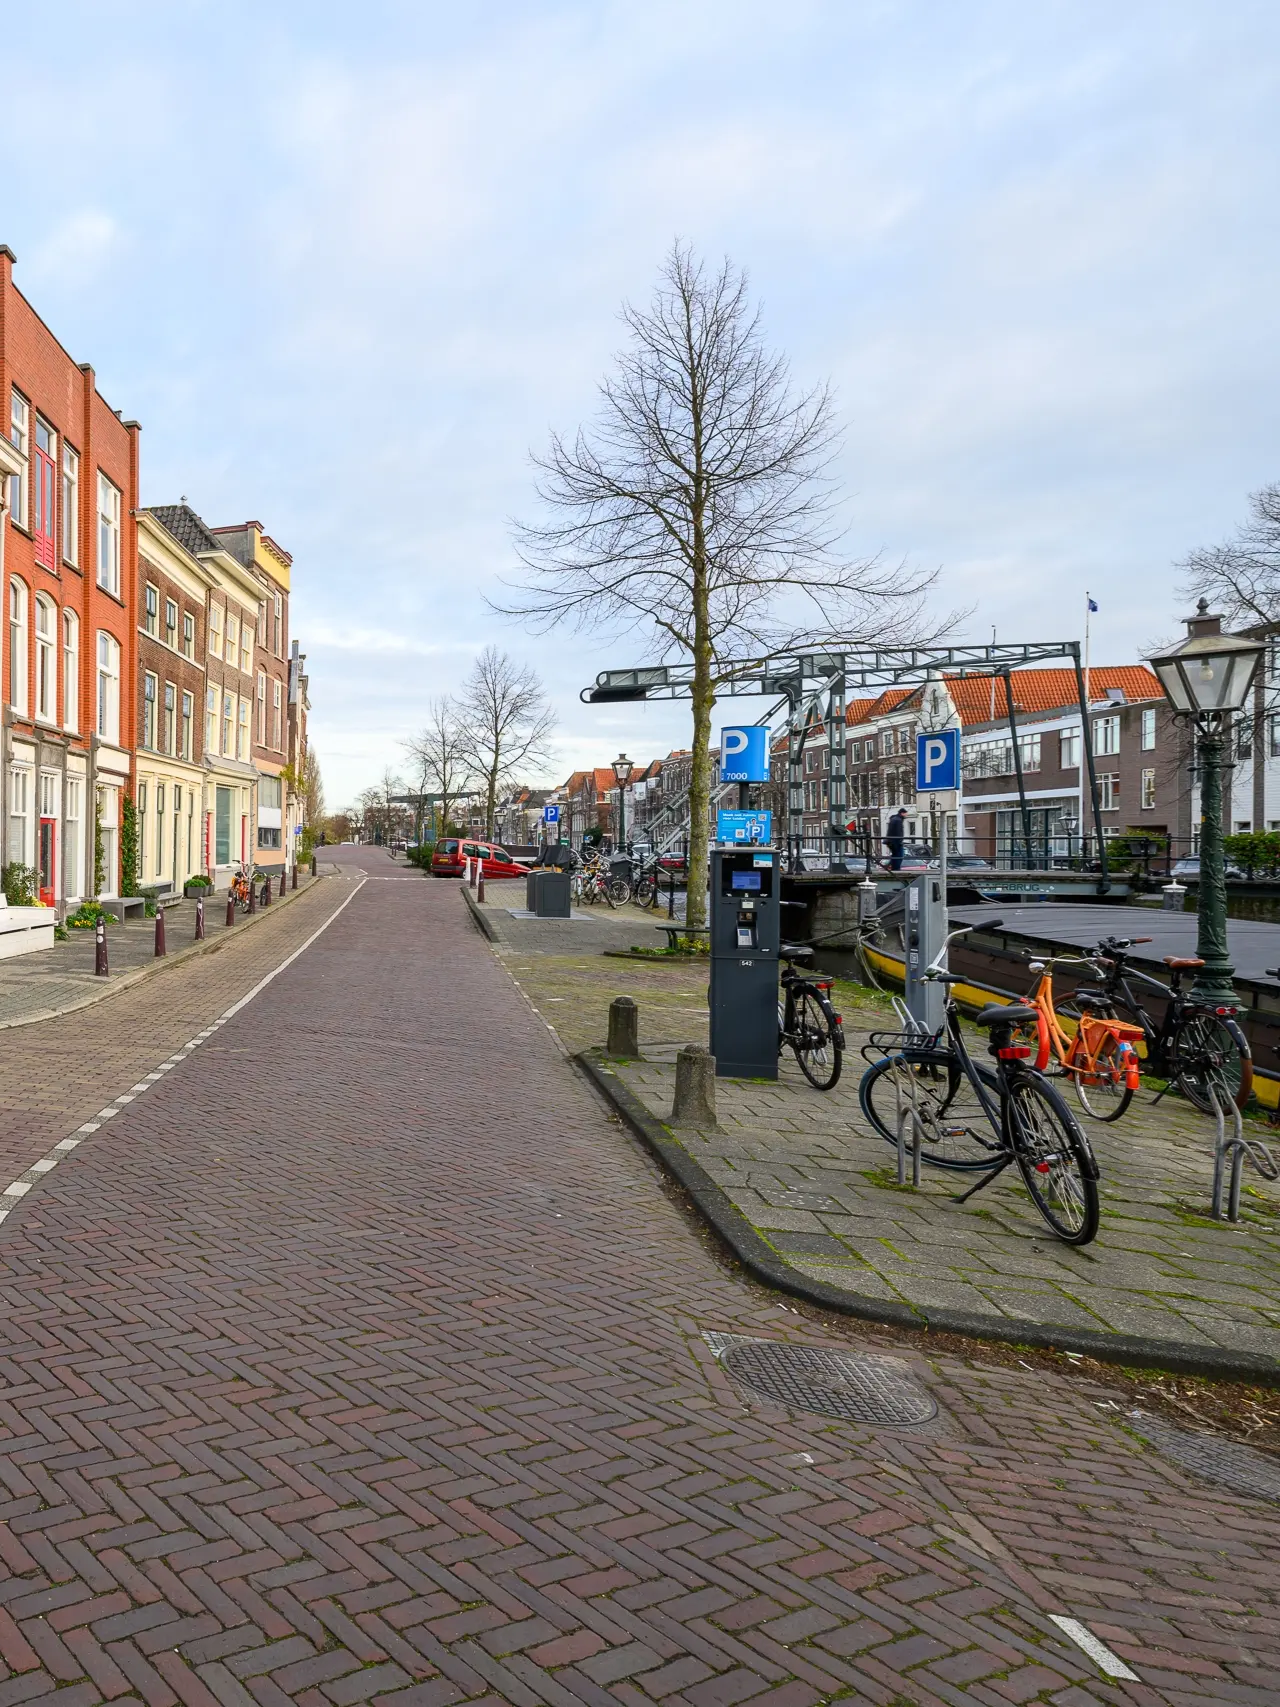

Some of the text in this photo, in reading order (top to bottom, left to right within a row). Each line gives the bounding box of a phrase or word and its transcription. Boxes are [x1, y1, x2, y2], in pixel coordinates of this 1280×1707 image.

[722, 730, 749, 769] P
[925, 739, 947, 784] P
[726, 772, 748, 780] 7000
[547, 808, 556, 821] P
[751, 826, 761, 837] P
